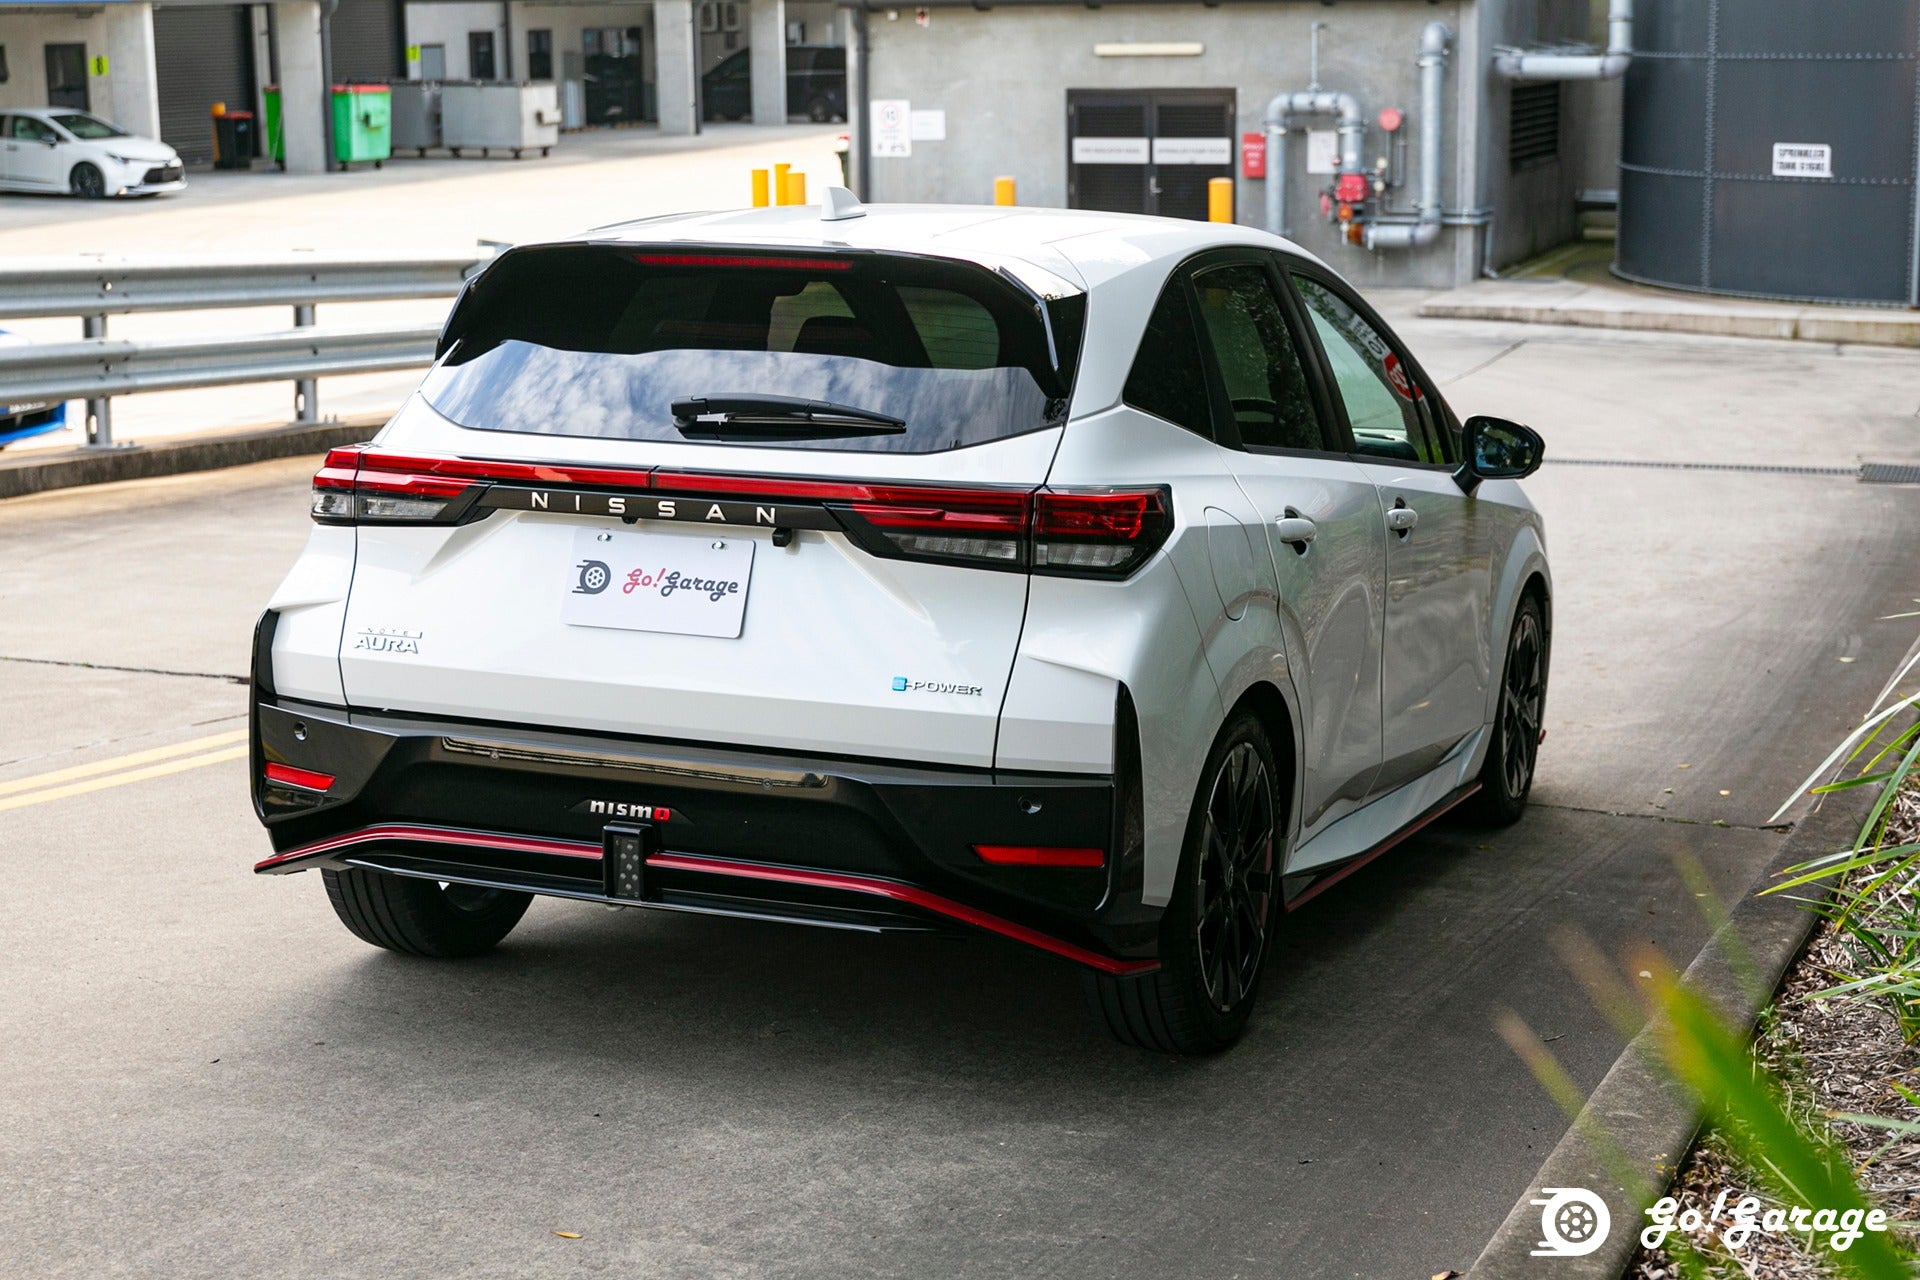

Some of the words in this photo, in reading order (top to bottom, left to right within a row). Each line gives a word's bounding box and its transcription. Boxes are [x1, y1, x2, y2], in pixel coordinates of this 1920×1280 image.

[531, 491, 777, 525] NISSAN
[354, 636, 419, 655] AURA
[892, 675, 983, 696] -POWER
[589, 799, 672, 822] nismo
